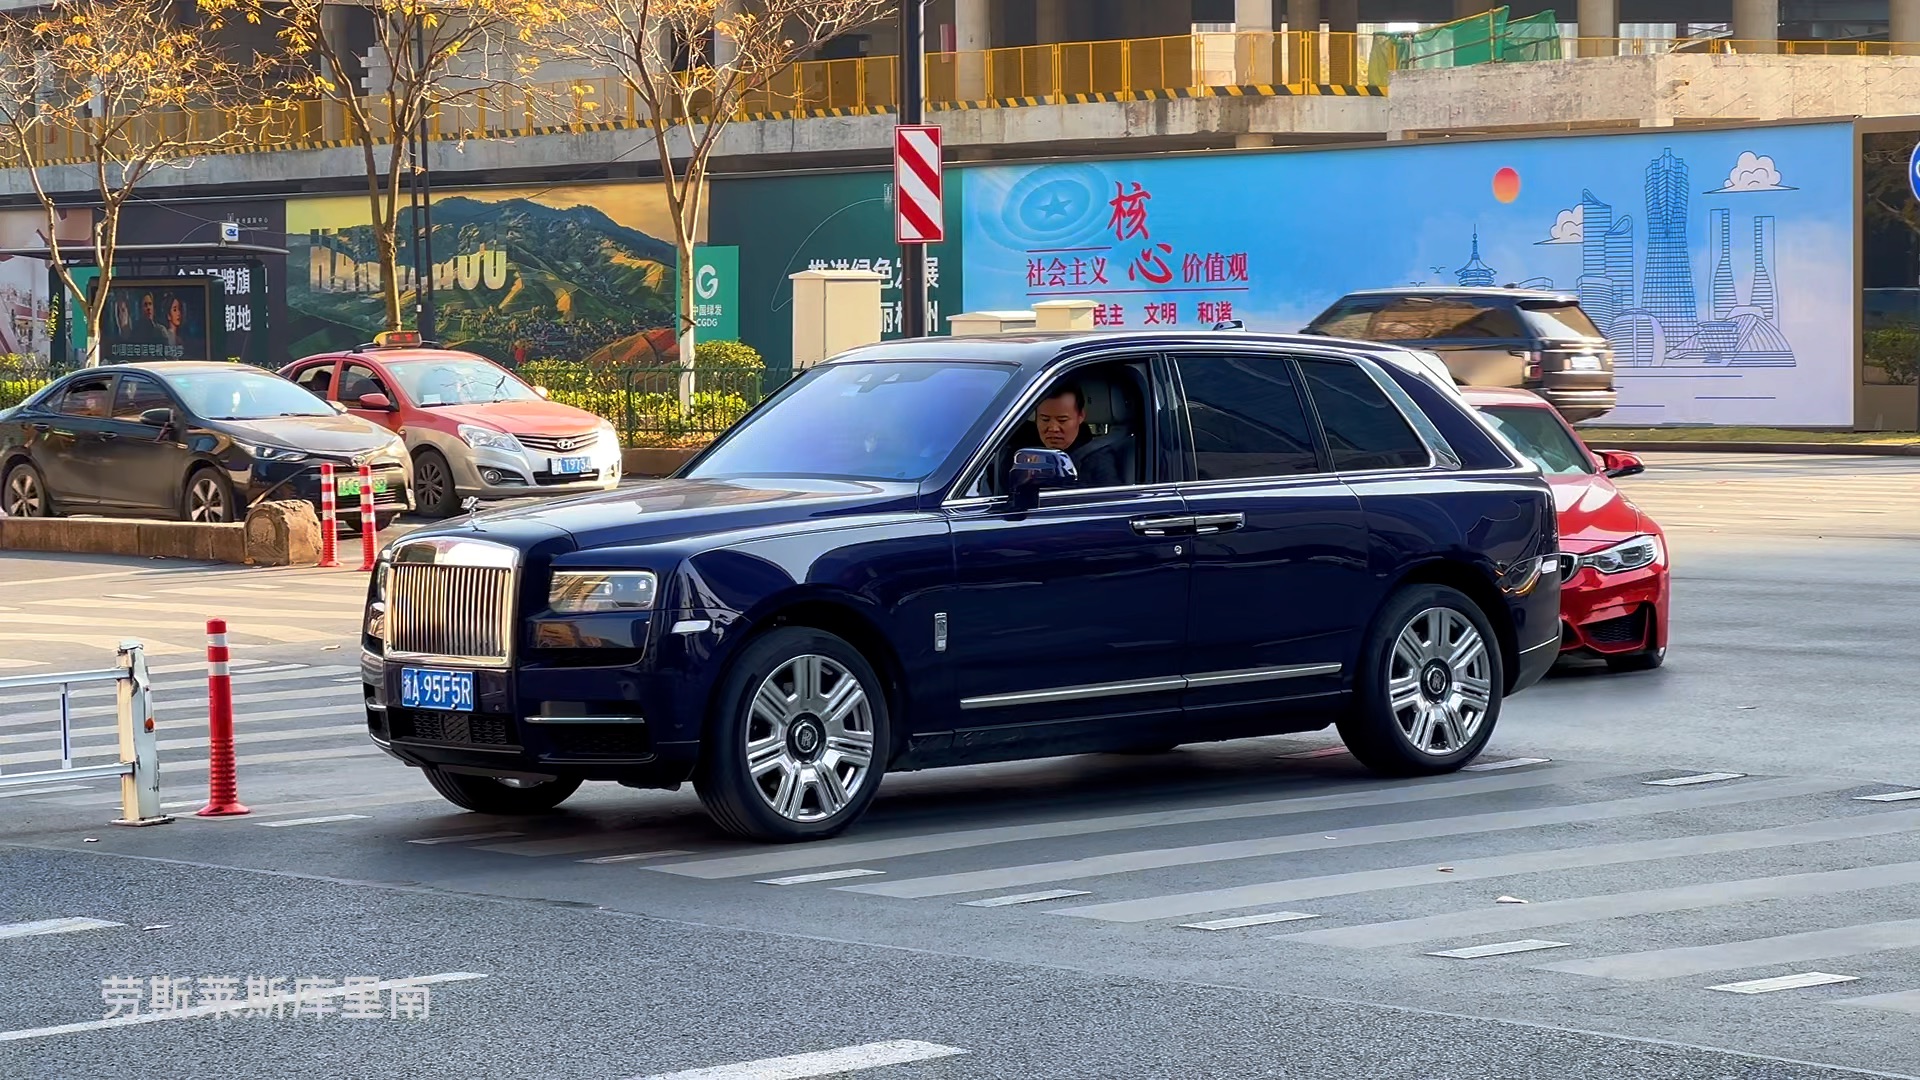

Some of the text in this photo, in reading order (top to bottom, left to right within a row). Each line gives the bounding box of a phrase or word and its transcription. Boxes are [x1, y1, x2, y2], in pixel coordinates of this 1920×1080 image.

[1107, 180, 1152, 242] 核
[310, 228, 507, 292] HANHOU
[1026, 243, 1249, 288] 社会主义 心 价值观
[1093, 301, 1233, 326] 民主 文明 和谐
